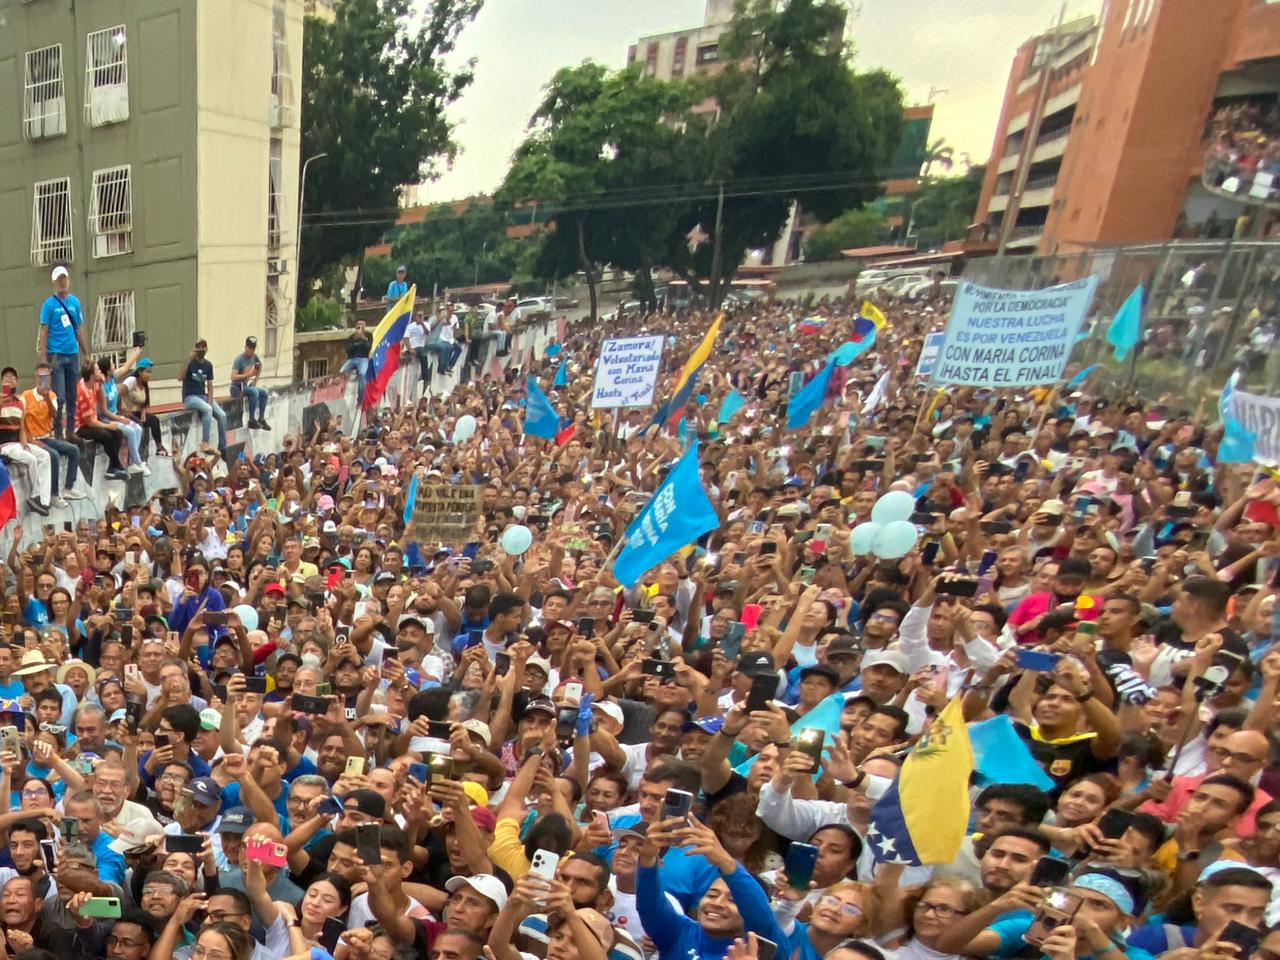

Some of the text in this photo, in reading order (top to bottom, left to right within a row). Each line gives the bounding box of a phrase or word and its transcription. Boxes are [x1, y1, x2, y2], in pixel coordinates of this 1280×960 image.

[973, 301, 992, 313] POR
[993, 301, 1006, 313] LA
[967, 313, 1065, 328] NUESTRA LUCHA
[956, 328, 1067, 344] ES POR VENEZUELA
[945, 344, 973, 362] CON
[973, 347, 1015, 363] MARIA
[1018, 343, 1066, 363] CORINA
[993, 367, 1011, 382] EL
[1016, 363, 1062, 381] FINAL!
